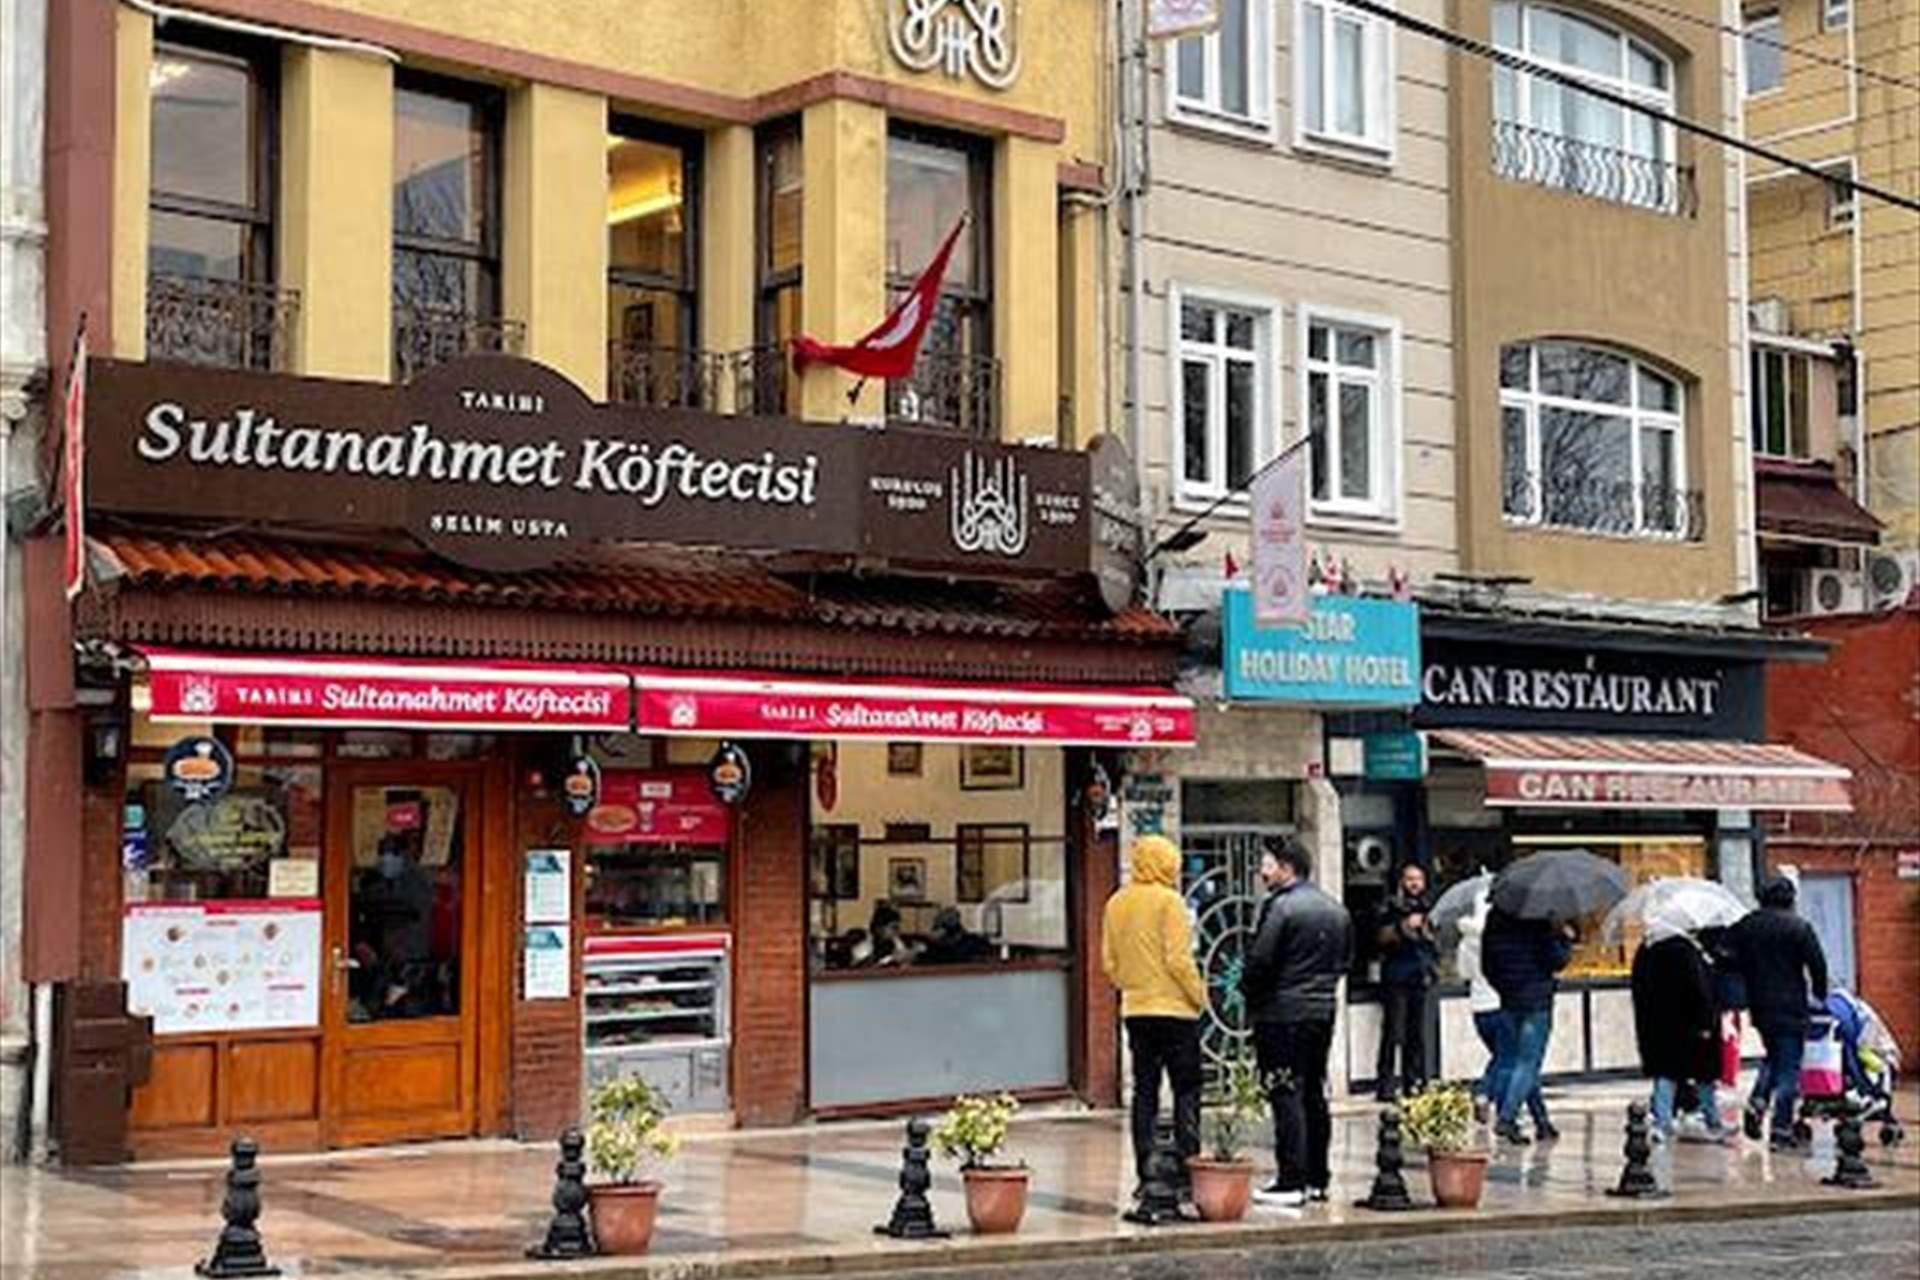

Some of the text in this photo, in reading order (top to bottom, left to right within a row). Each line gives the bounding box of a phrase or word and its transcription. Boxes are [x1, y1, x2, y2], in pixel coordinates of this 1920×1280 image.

[137, 403, 818, 505] Sultanahmet Köftecisi
[511, 518, 569, 538] USTA
[1301, 610, 1356, 642] STAR
[1239, 649, 1412, 687] HOLIDAY HOTEL
[321, 682, 498, 714] Sultanahmet
[502, 686, 611, 720] Köftecisi
[1423, 664, 1719, 715] CAN RESTAURANT
[825, 703, 957, 730] Sultanahmet
[1518, 772, 1597, 800] CAN
